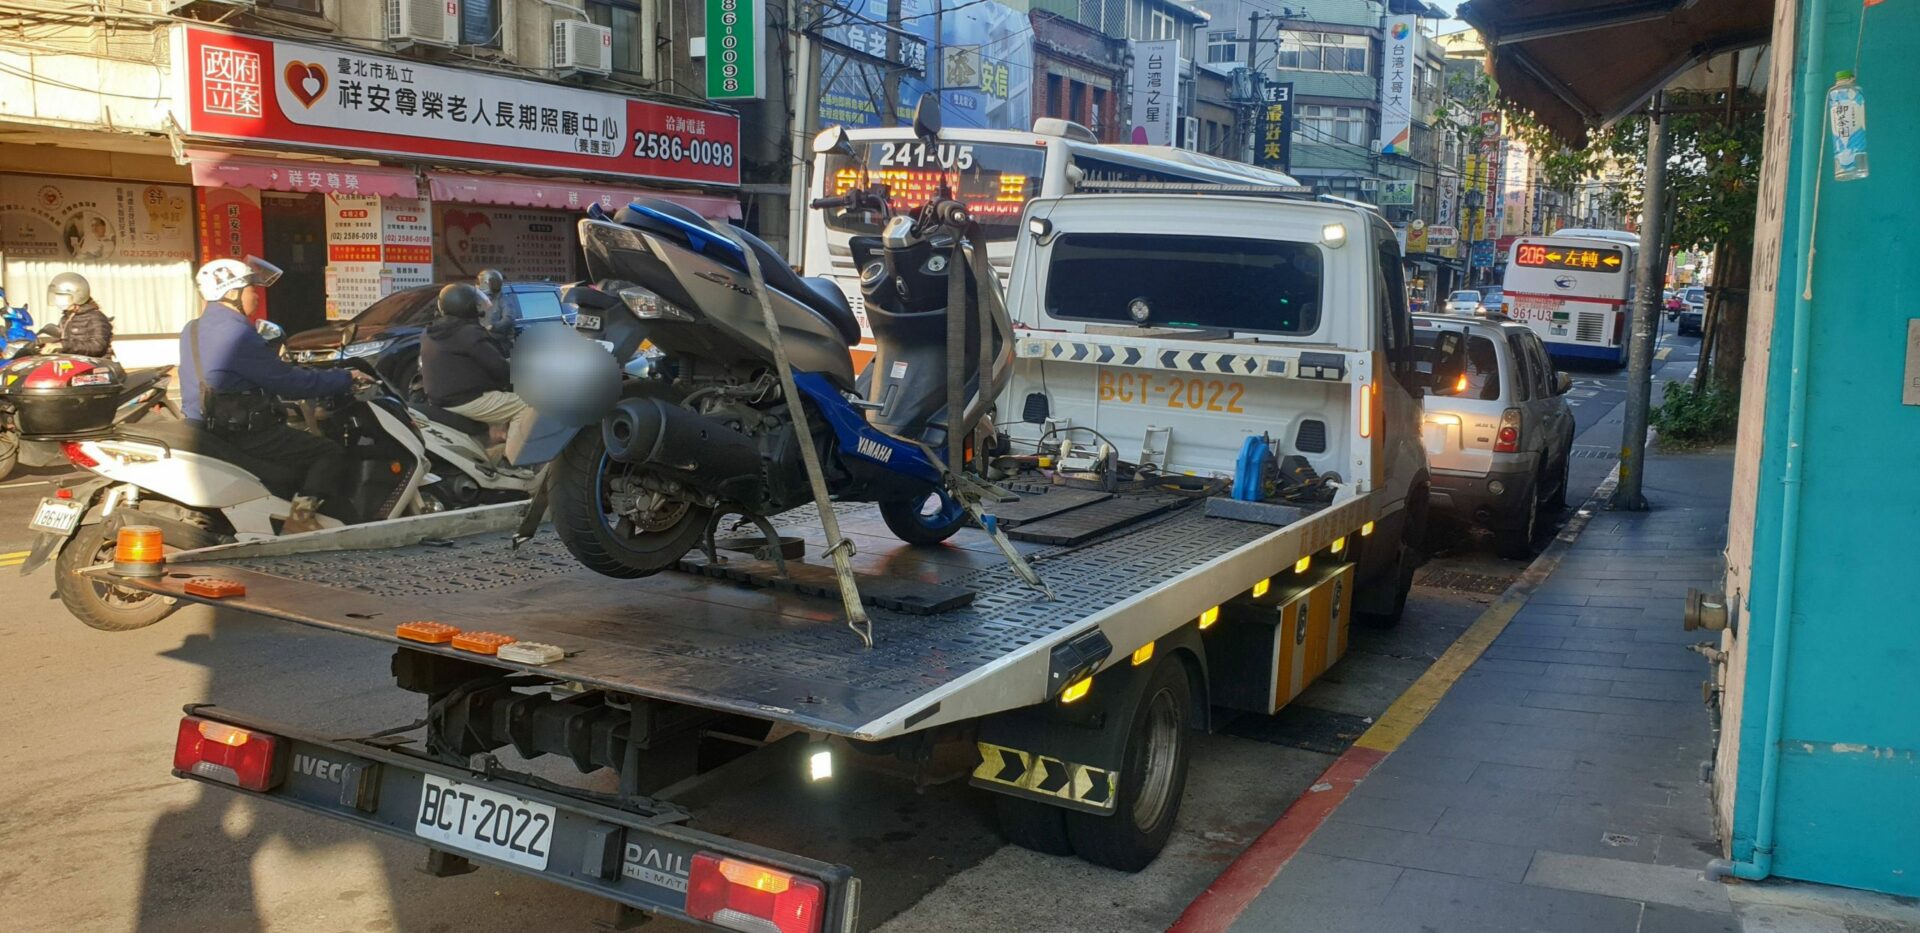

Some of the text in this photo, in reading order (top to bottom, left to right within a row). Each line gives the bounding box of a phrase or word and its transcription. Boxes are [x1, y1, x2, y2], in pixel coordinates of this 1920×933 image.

[206, 51, 258, 82] 政府
[338, 57, 414, 84] 臺北市私立
[207, 83, 260, 114] 立案
[338, 79, 618, 140] 祥安尊榮老人長期照顧中心
[665, 115, 706, 136] 洽詢電話
[634, 130, 734, 168] 2586-0098
[880, 142, 974, 170] 241-U5
[288, 168, 361, 190] 祥安尊榮
[1518, 246, 1545, 265] 206
[1564, 251, 1599, 269] 左轉
[1512, 307, 1552, 322] 961-U3
[1099, 370, 1245, 414] BCT-2022
[857, 436, 893, 463] YAMAHA
[625, 842, 689, 876] DAIL
